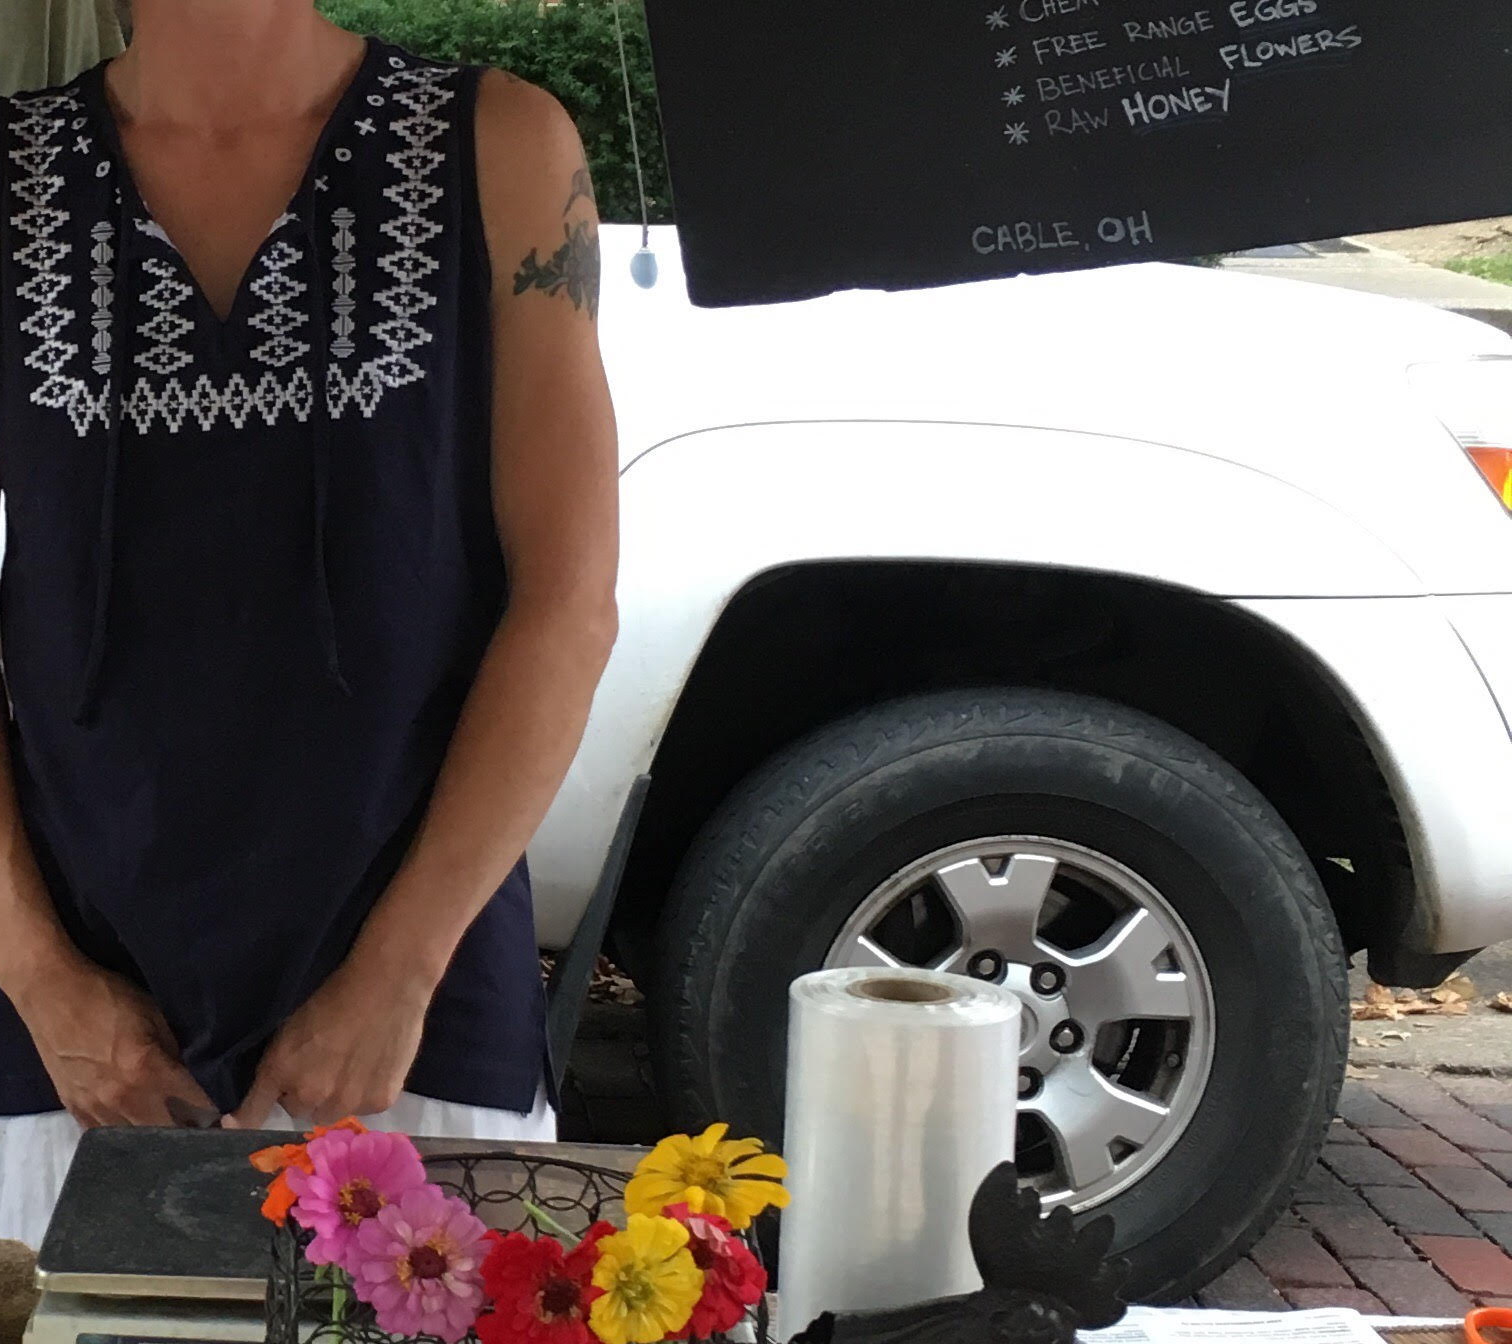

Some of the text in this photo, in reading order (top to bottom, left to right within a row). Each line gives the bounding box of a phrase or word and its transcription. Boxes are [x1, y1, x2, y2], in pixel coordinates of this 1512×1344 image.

[1032, 29, 1108, 65] FREE
[1122, 10, 1215, 43] RANGE
[1035, 24, 1362, 102] BENEFICIAL FLOWERS
[1044, 78, 1231, 136] RAW HONEY
[1096, 210, 1154, 246] OH
